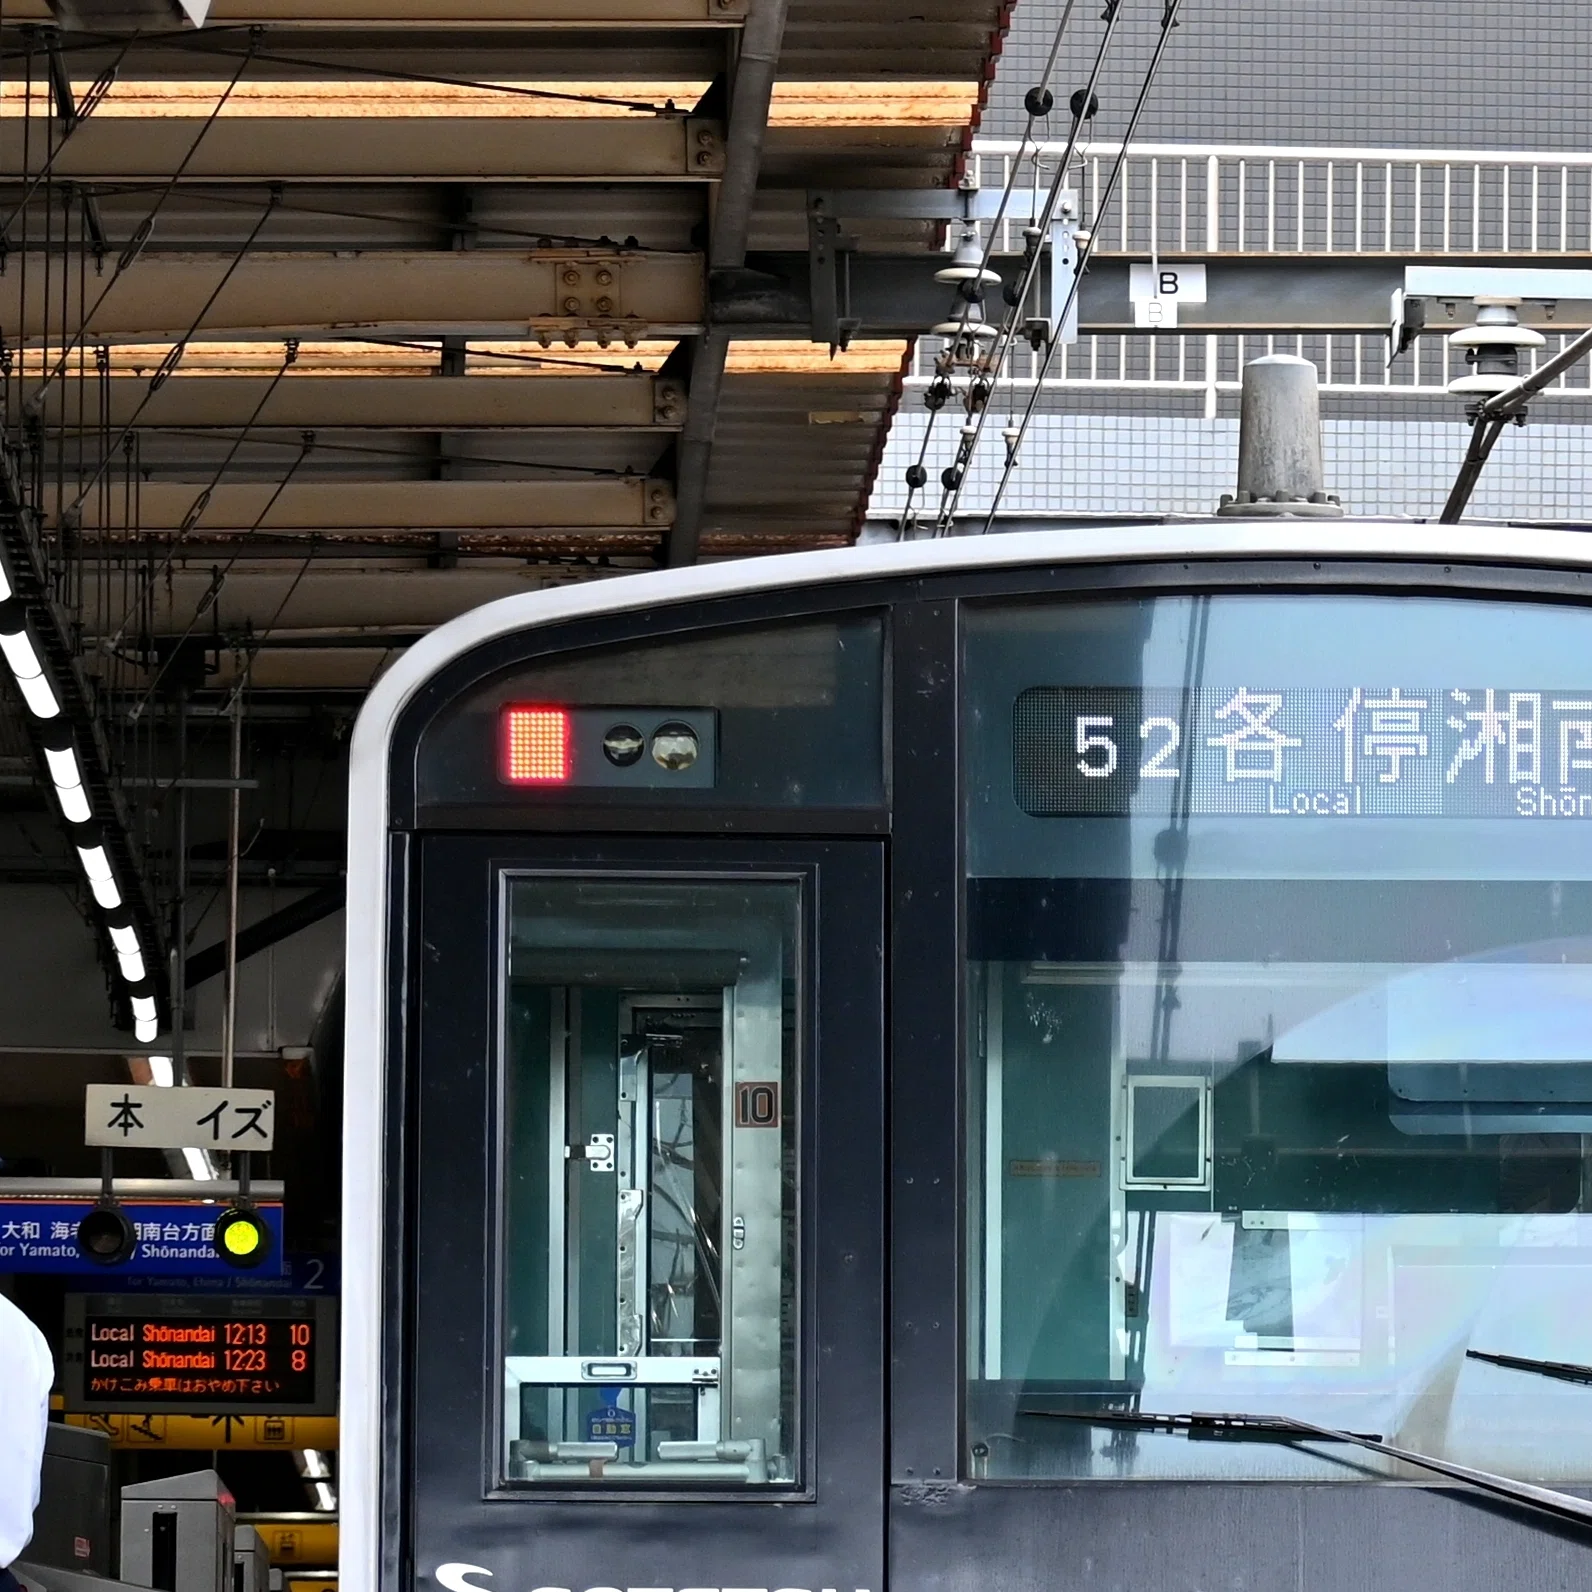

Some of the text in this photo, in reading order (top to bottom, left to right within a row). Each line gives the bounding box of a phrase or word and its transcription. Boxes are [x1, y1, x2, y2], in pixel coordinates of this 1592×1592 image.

[1159, 272, 1179, 295] B
[1148, 302, 1163, 322] B
[1074, 716, 1181, 779] 52
[1205, 686, 1429, 784] 各停
[1268, 785, 1362, 815] Local
[107, 1093, 272, 1140] 本 イズ
[739, 1086, 775, 1124] 10
[1, 1221, 40, 1240] 大和
[19, 1242, 80, 1259] Yamato,
[303, 1258, 325, 1290] 2
[90, 1323, 135, 1342] Local
[142, 1324, 215, 1343] Shōnandai
[223, 1323, 266, 1345] 12:13
[290, 1324, 310, 1346] 10
[90, 1349, 135, 1369] Local
[142, 1349, 215, 1369] Shōnandai
[223, 1349, 266, 1371] 12:23
[291, 1351, 306, 1371] 8
